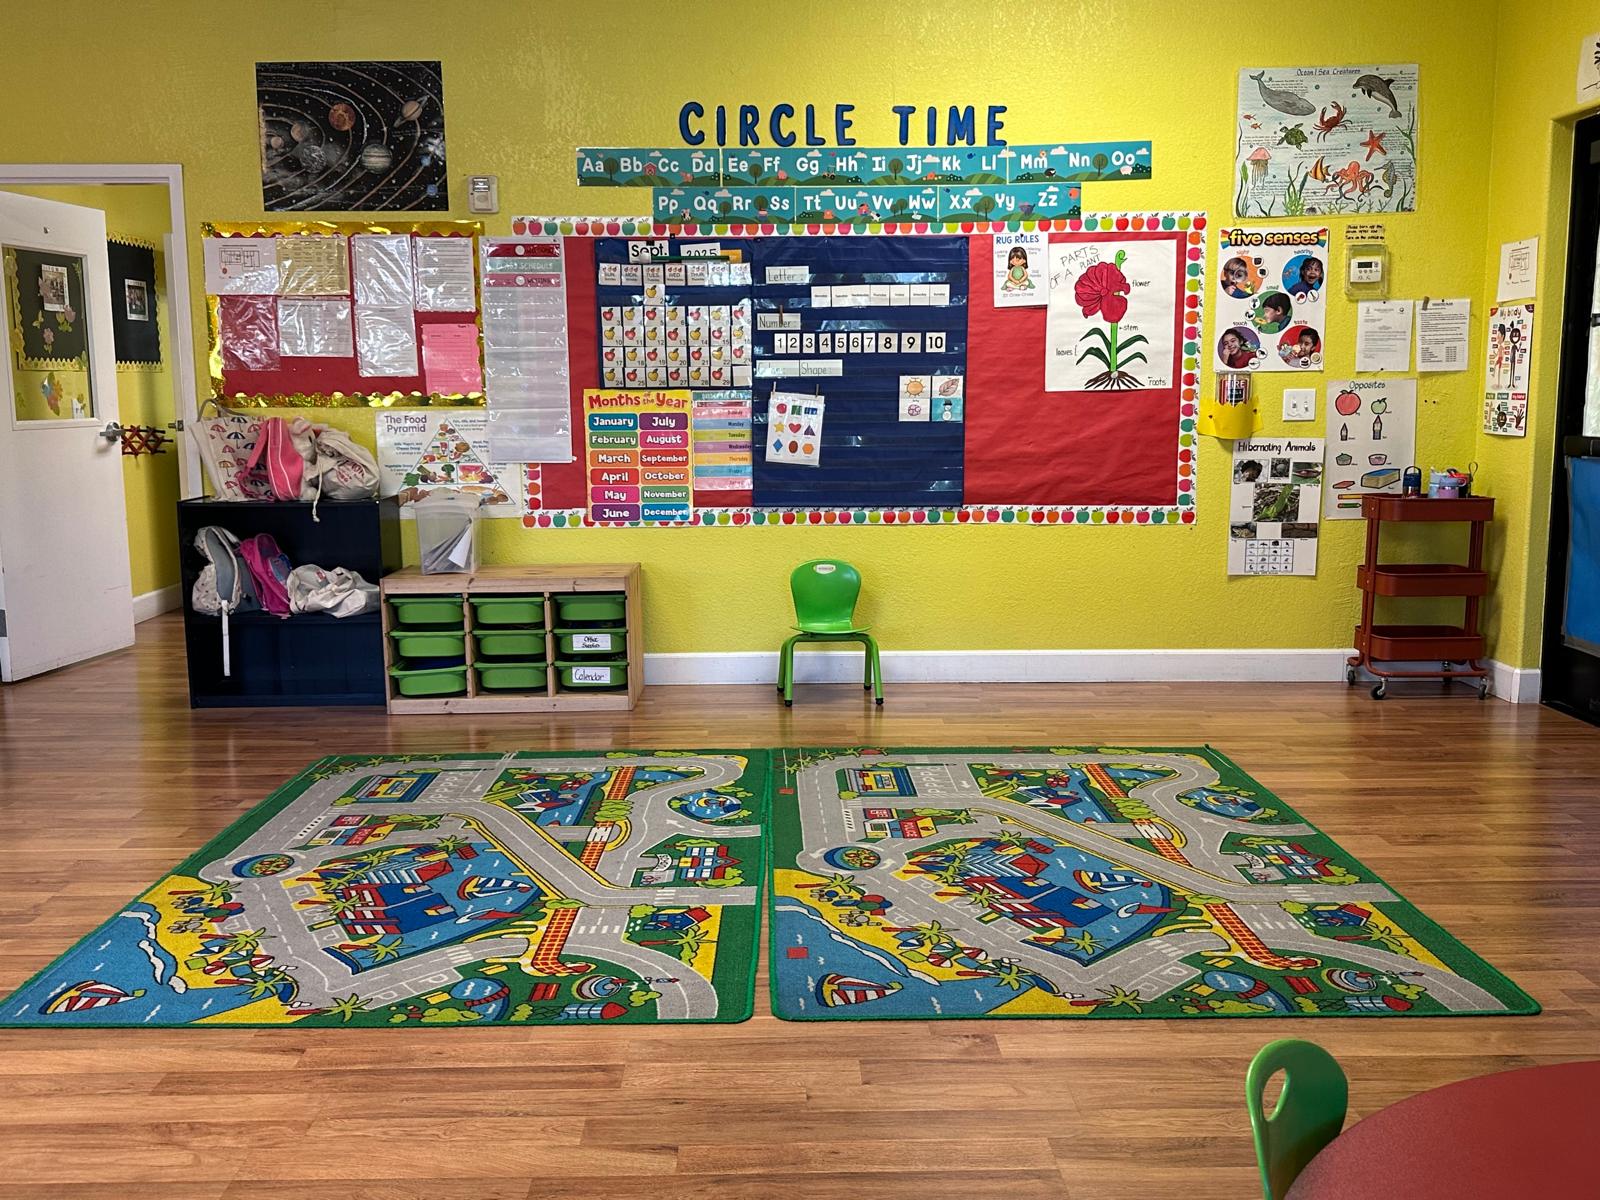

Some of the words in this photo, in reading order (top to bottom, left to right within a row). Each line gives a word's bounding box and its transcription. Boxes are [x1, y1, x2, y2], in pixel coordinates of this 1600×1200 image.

[679, 102, 856, 147] CIRCLE
[892, 105, 1007, 146] TIME
[583, 158, 604, 172] Aa
[620, 158, 642, 172] Bb
[658, 158, 679, 172] Cc
[693, 157, 714, 172] Dd
[729, 158, 748, 171] Ee
[764, 157, 780, 172] Ff
[796, 158, 818, 176] Gg
[836, 157, 857, 171] Hh
[872, 157, 885, 171] Ii
[906, 156, 922, 174] Jj
[942, 156, 961, 171] Kk
[982, 156, 996, 170] Ll
[1021, 153, 1048, 168] Mm
[1069, 153, 1090, 167] Nn
[1112, 151, 1135, 166] Oo
[659, 196, 678, 213] Pp
[694, 196, 718, 214] Qq
[733, 196, 751, 210] Rr
[770, 196, 789, 210] Ss
[804, 196, 821, 210] Tt
[835, 196, 856, 210] Uu
[872, 195, 892, 209] Vv
[909, 195, 935, 209] Ww
[950, 195, 971, 209] Xx
[995, 194, 1015, 211] Yy
[1039, 192, 1057, 207] Zz
[996, 236, 1012, 244] RUG
[1015, 235, 1039, 243] RULES
[1229, 229, 1263, 245] five
[1265, 231, 1318, 245] senses
[1060, 245, 1098, 266] PARTS
[1064, 269, 1073, 280] A
[1080, 254, 1101, 270] PLANT
[1132, 279, 1151, 287] flower
[1507, 308, 1521, 318] body
[778, 338, 782, 348] 1
[789, 337, 797, 347] 2
[806, 337, 813, 347] 3
[822, 337, 829, 347] 4
[837, 337, 844, 347] 5
[852, 337, 859, 347] 6
[866, 337, 873, 347] 7
[884, 337, 892, 349] 8
[907, 337, 916, 349] 9
[929, 336, 943, 348] 10
[1149, 378, 1166, 386] roots
[1349, 381, 1385, 390] Opposites
[588, 395, 640, 409] Months
[656, 393, 688, 409] Year
[384, 415, 402, 423] The
[405, 415, 427, 423] Food
[593, 417, 633, 427] January
[651, 416, 676, 428] July
[387, 425, 426, 434] Pyramid
[591, 435, 636, 445] February
[646, 435, 682, 444] August
[1238, 442, 1281, 454] Hibernating
[1285, 441, 1316, 451] Animals
[598, 454, 631, 463] March
[641, 454, 687, 463] September
[602, 472, 629, 484] April
[604, 490, 626, 501] May
[643, 490, 687, 499] November
[602, 508, 630, 518] June
[575, 669, 604, 681] Calendar
